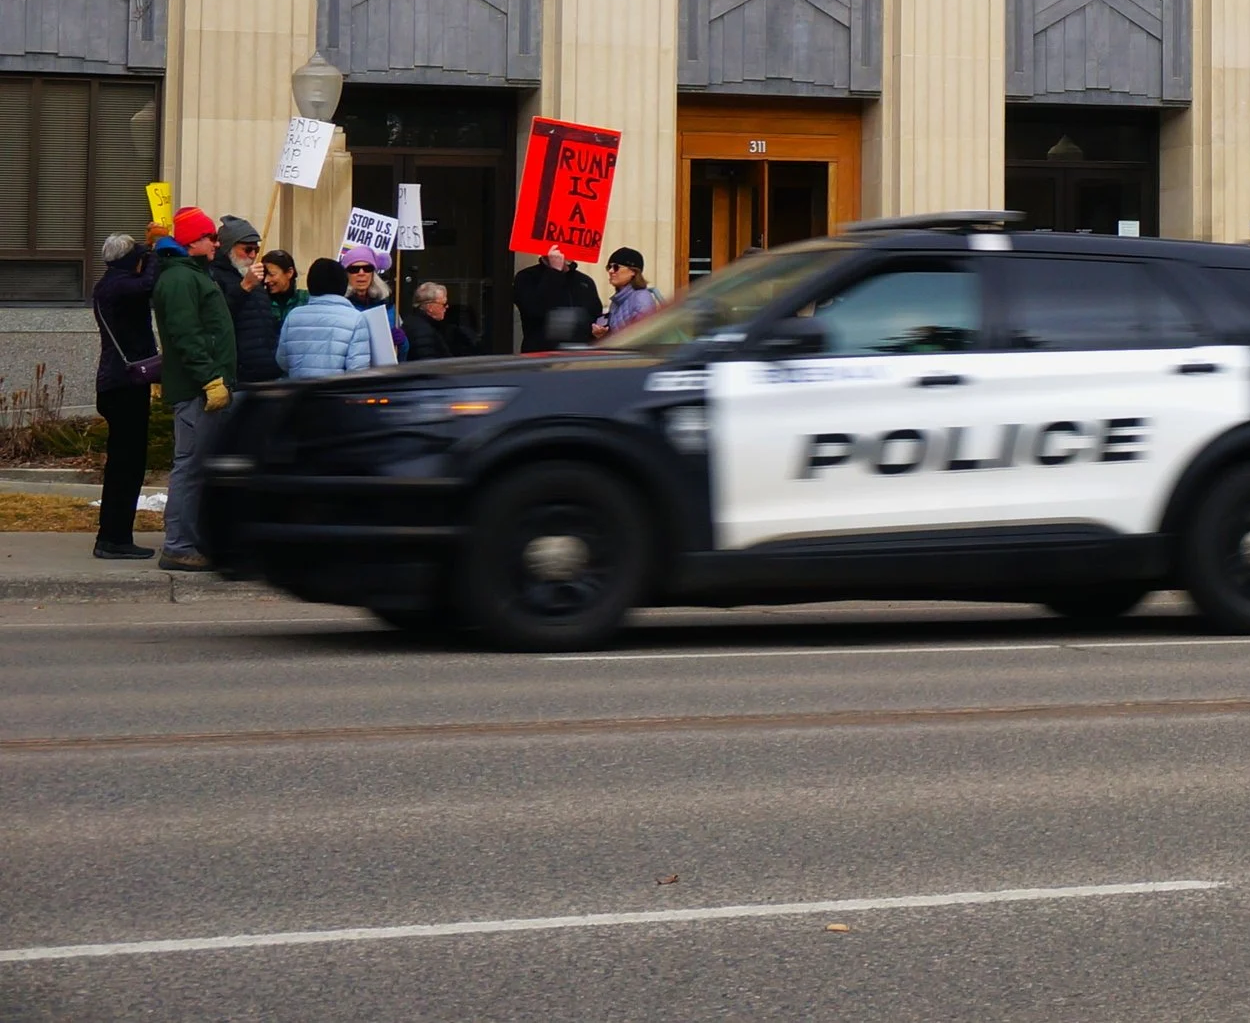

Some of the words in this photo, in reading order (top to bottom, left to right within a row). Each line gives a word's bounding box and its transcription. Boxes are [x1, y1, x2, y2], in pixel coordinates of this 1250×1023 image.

[750, 141, 766, 153] 311
[568, 176, 601, 200] IS
[350, 213, 375, 229] STOP
[375, 220, 392, 236] U.S.
[568, 202, 586, 224] A
[347, 226, 373, 246] WAR
[374, 234, 391, 251] ON
[796, 417, 1151, 480] POLICE
